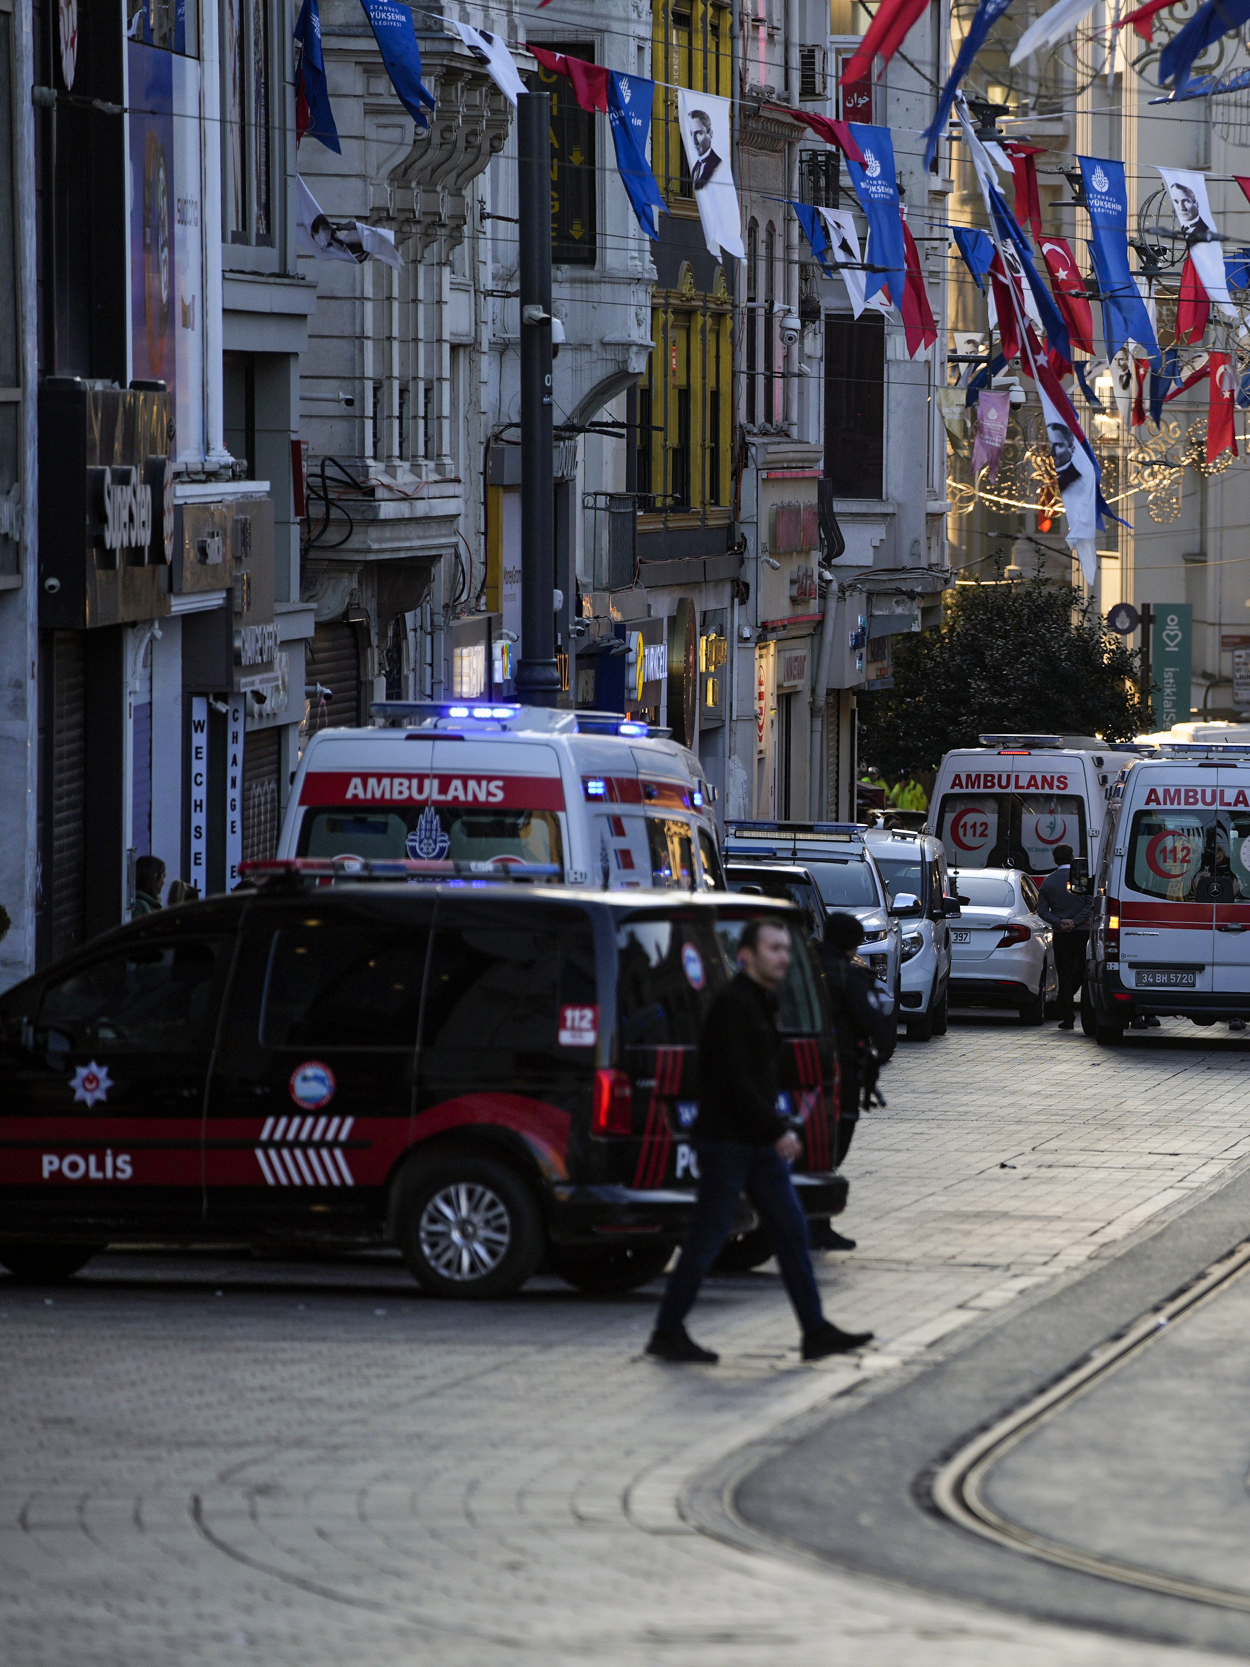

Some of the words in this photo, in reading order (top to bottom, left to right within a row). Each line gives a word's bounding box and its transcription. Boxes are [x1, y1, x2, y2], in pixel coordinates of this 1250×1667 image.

[370, 11, 406, 22] YÜKŞEHİR
[104, 466, 152, 570] SuperStep
[344, 777, 505, 803] AMBULANS
[950, 773, 1069, 790] AMBULANS
[960, 821, 989, 838] 112
[1159, 845, 1192, 864] 112
[953, 932, 969, 942] 397
[1142, 973, 1154, 983] 34
[1155, 973, 1168, 983] BH
[1170, 973, 1194, 984] 5720
[564, 1007, 595, 1030] 112
[42, 1149, 133, 1180] POLİS
